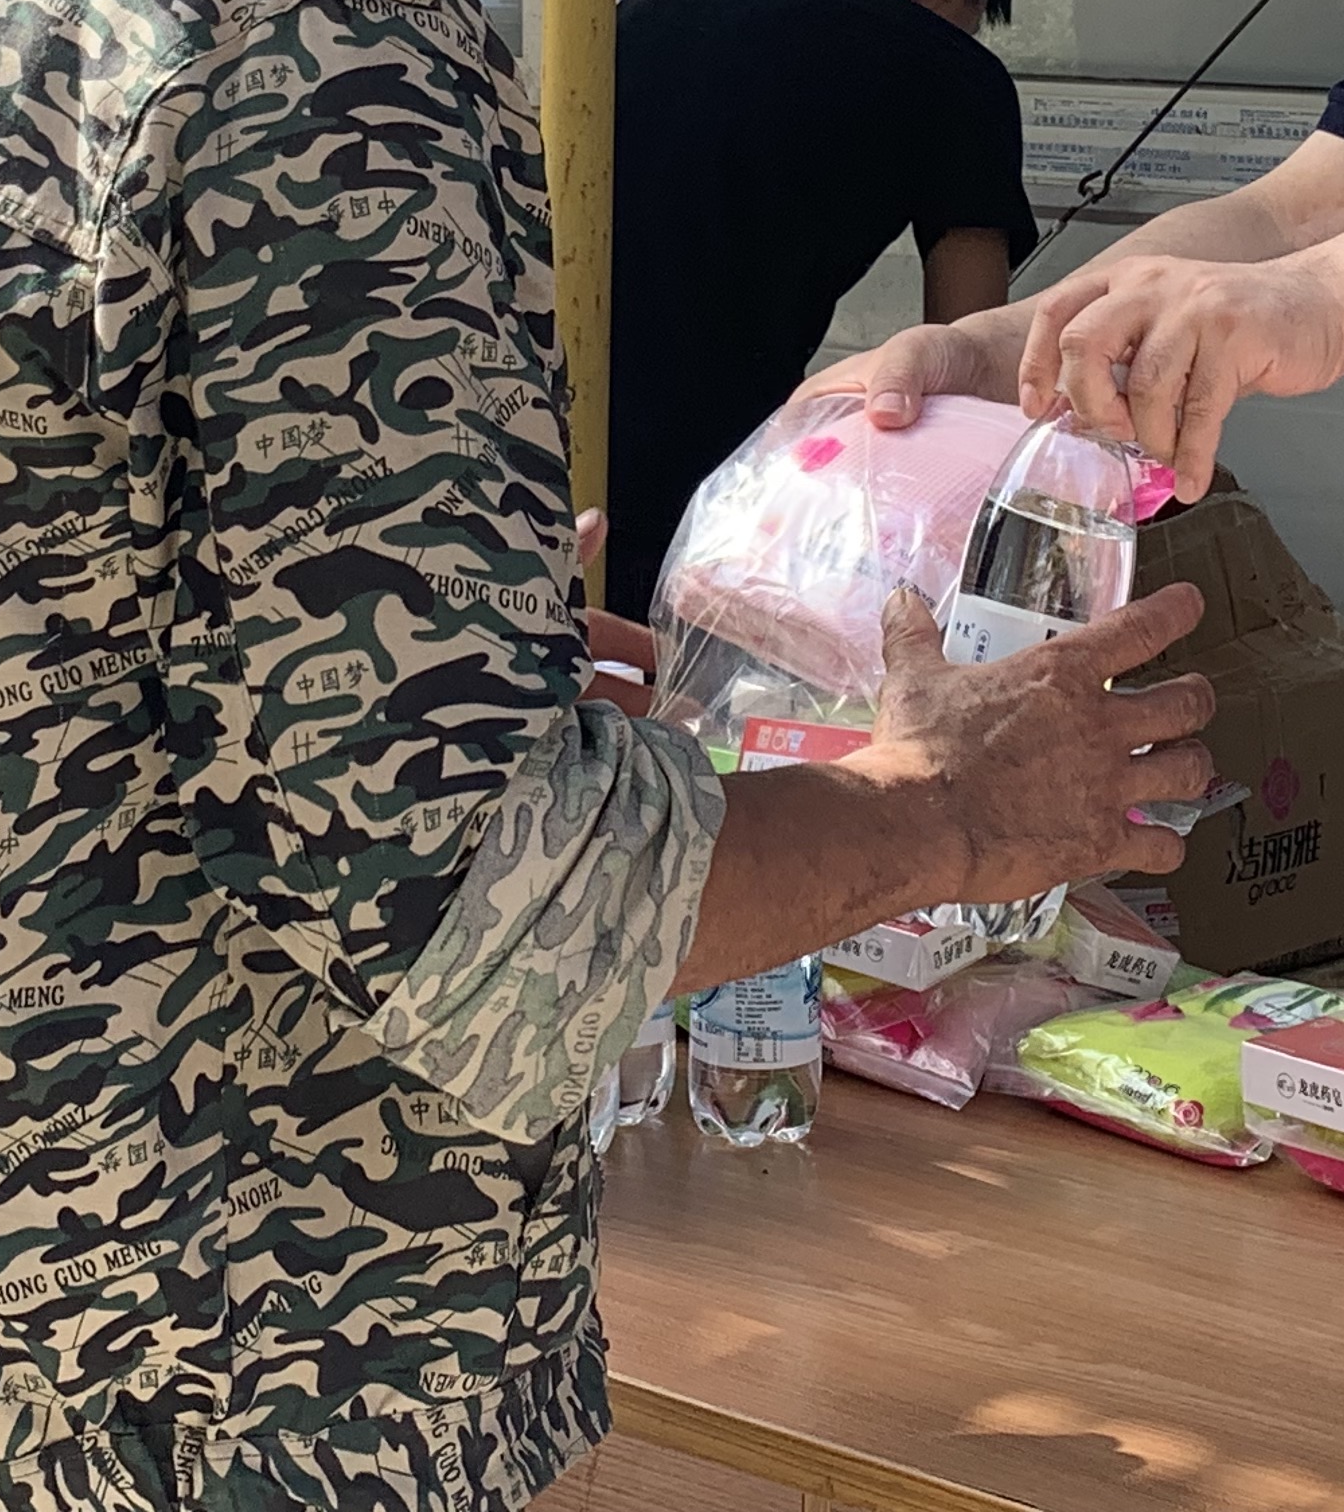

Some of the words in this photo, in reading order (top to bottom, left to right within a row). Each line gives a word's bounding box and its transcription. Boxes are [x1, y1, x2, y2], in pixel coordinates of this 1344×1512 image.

[413, 11, 451, 39] GUO
[225, 61, 293, 104] 中国梦
[458, 333, 517, 370] 中国梦
[256, 418, 332, 460] 中国梦
[283, 507, 325, 548] GUO
[423, 571, 491, 604] ZHONG
[499, 583, 539, 615] GUO
[40, 665, 83, 696] GUO
[90, 646, 148, 682] MENG
[296, 660, 370, 700] 中国梦
[1247, 872, 1298, 906] grace
[1107, 950, 1158, 981] 龙虎药皂
[7, 985, 65, 1011] MENG
[234, 1044, 303, 1073] 中国梦
[1299, 1077, 1343, 1108] 龙虎药皂
[97, 1137, 167, 1173] 中国梦
[54, 1259, 97, 1289] GUO
[106, 1240, 163, 1273] MENG
